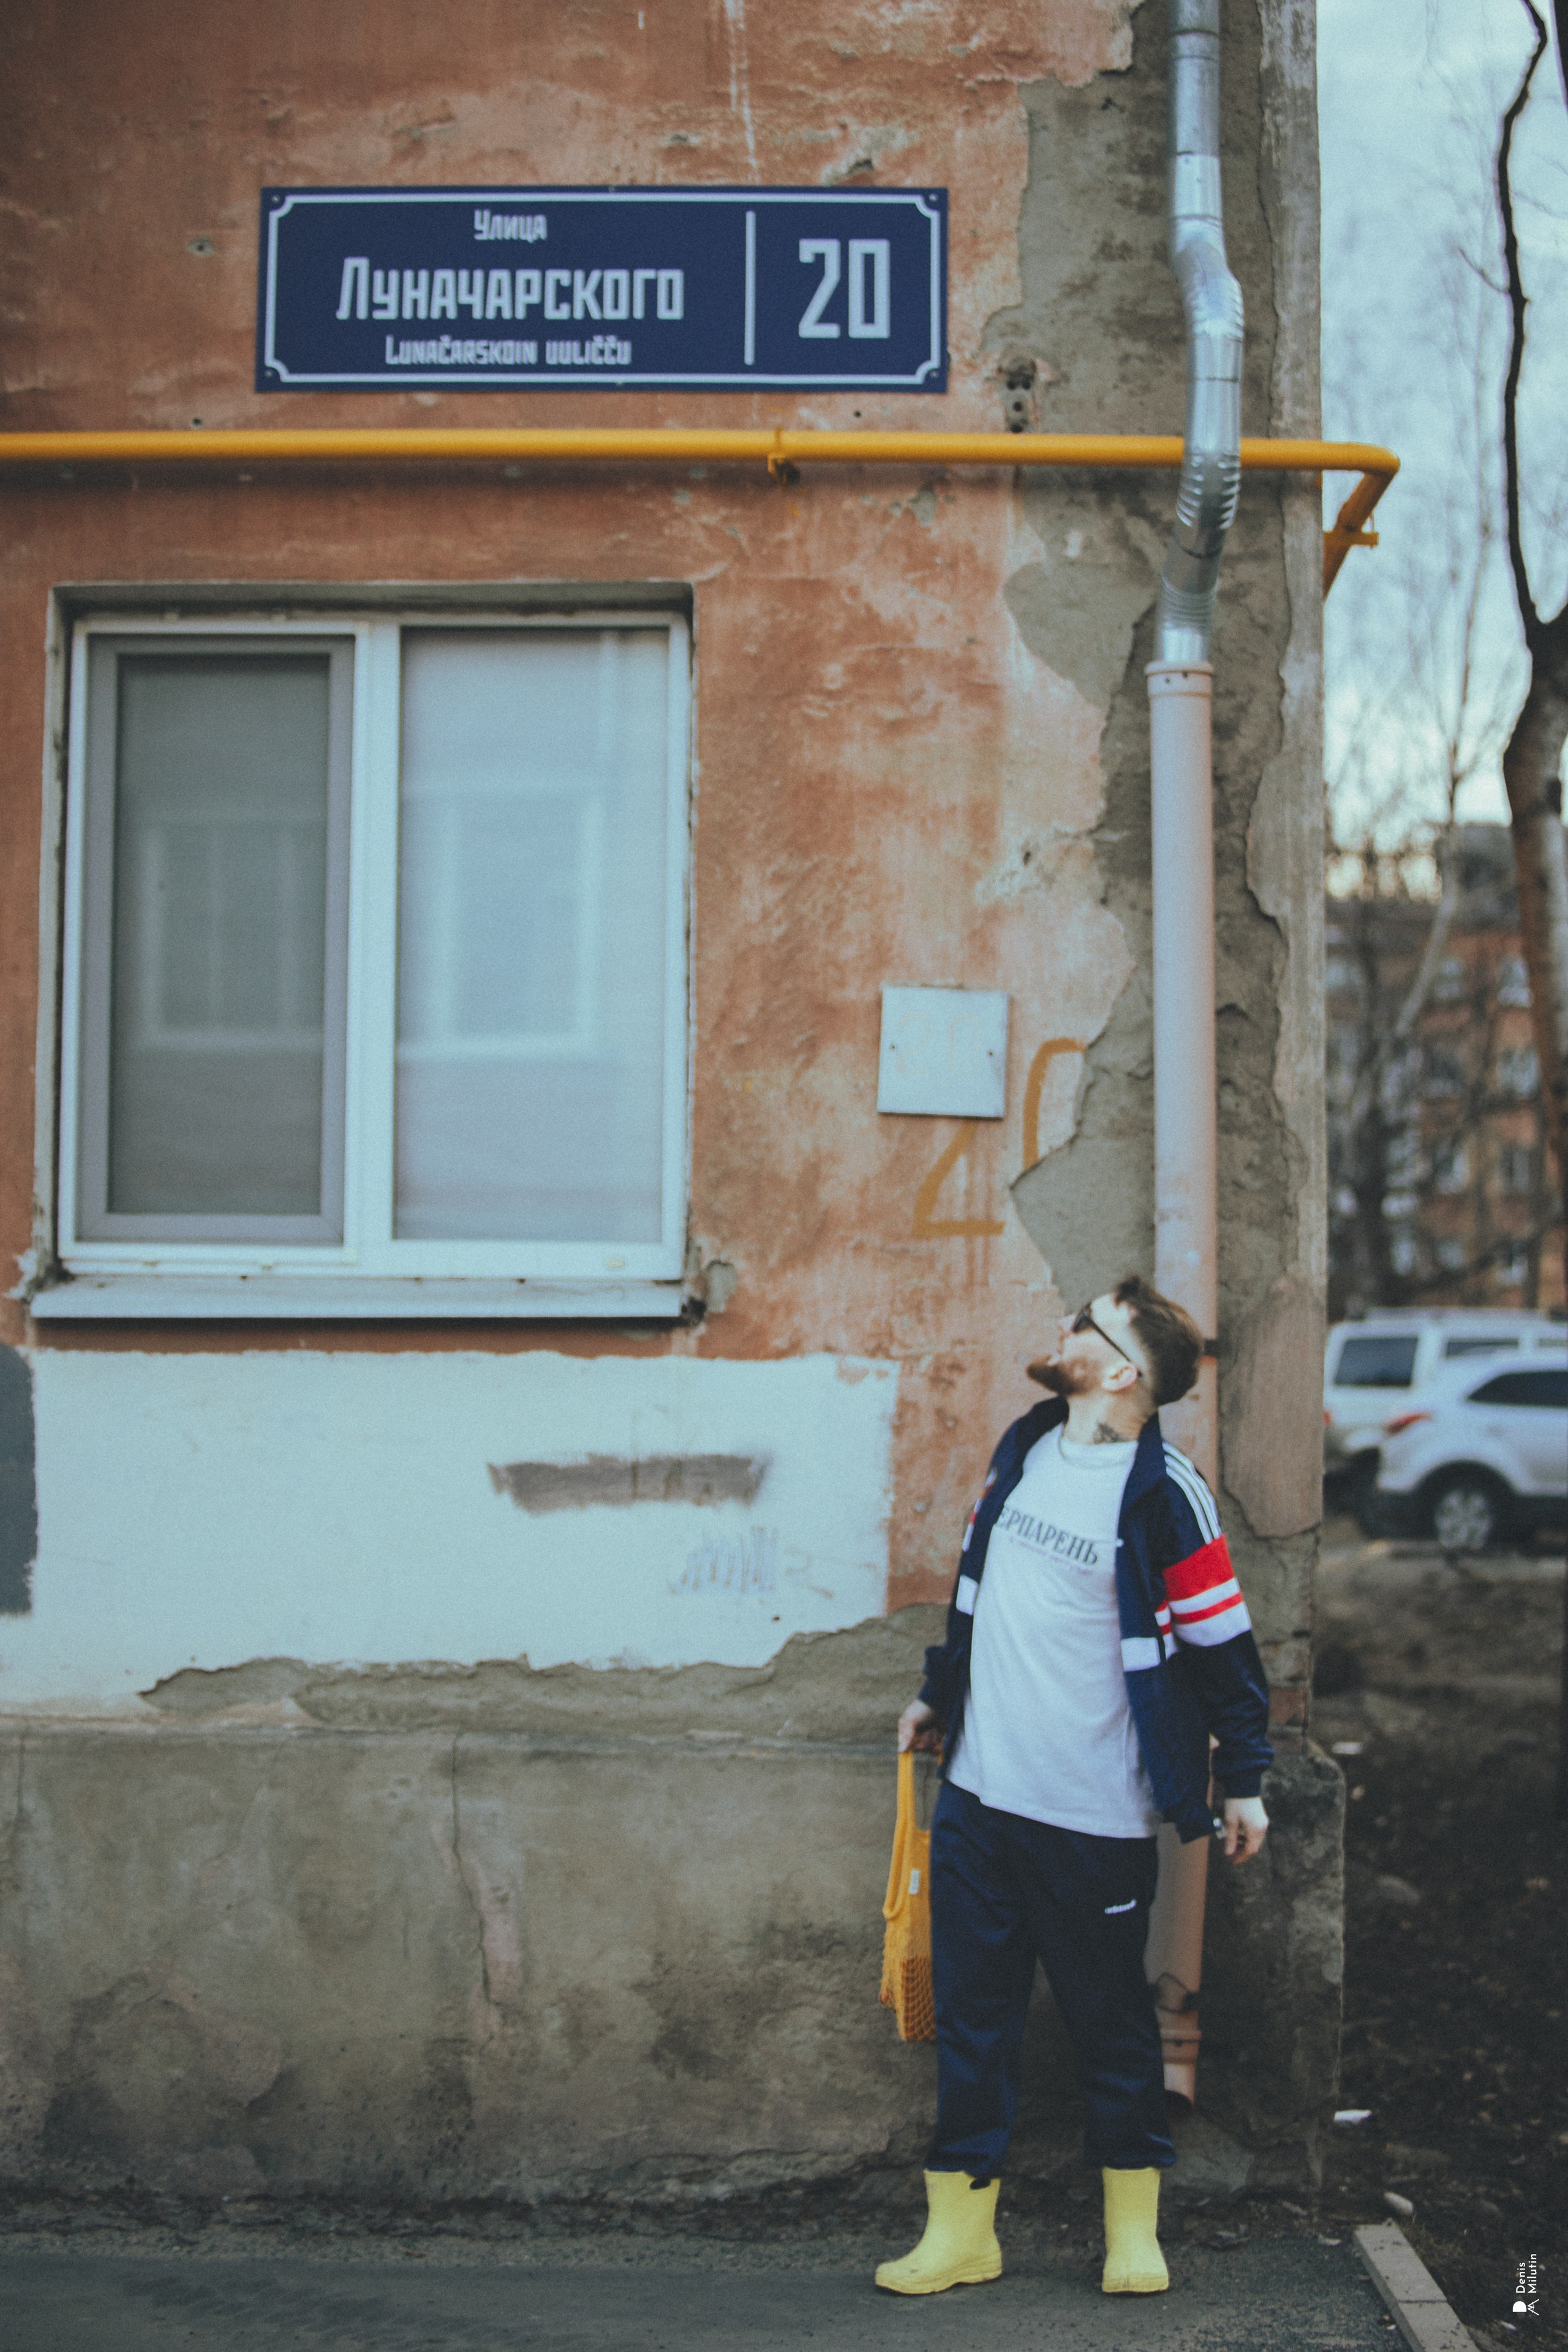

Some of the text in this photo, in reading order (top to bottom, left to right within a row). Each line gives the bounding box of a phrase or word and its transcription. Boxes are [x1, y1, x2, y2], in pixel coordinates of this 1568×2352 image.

[474, 209, 546, 243] Улица
[336, 257, 684, 320] Луначарского
[797, 238, 891, 339] 20
